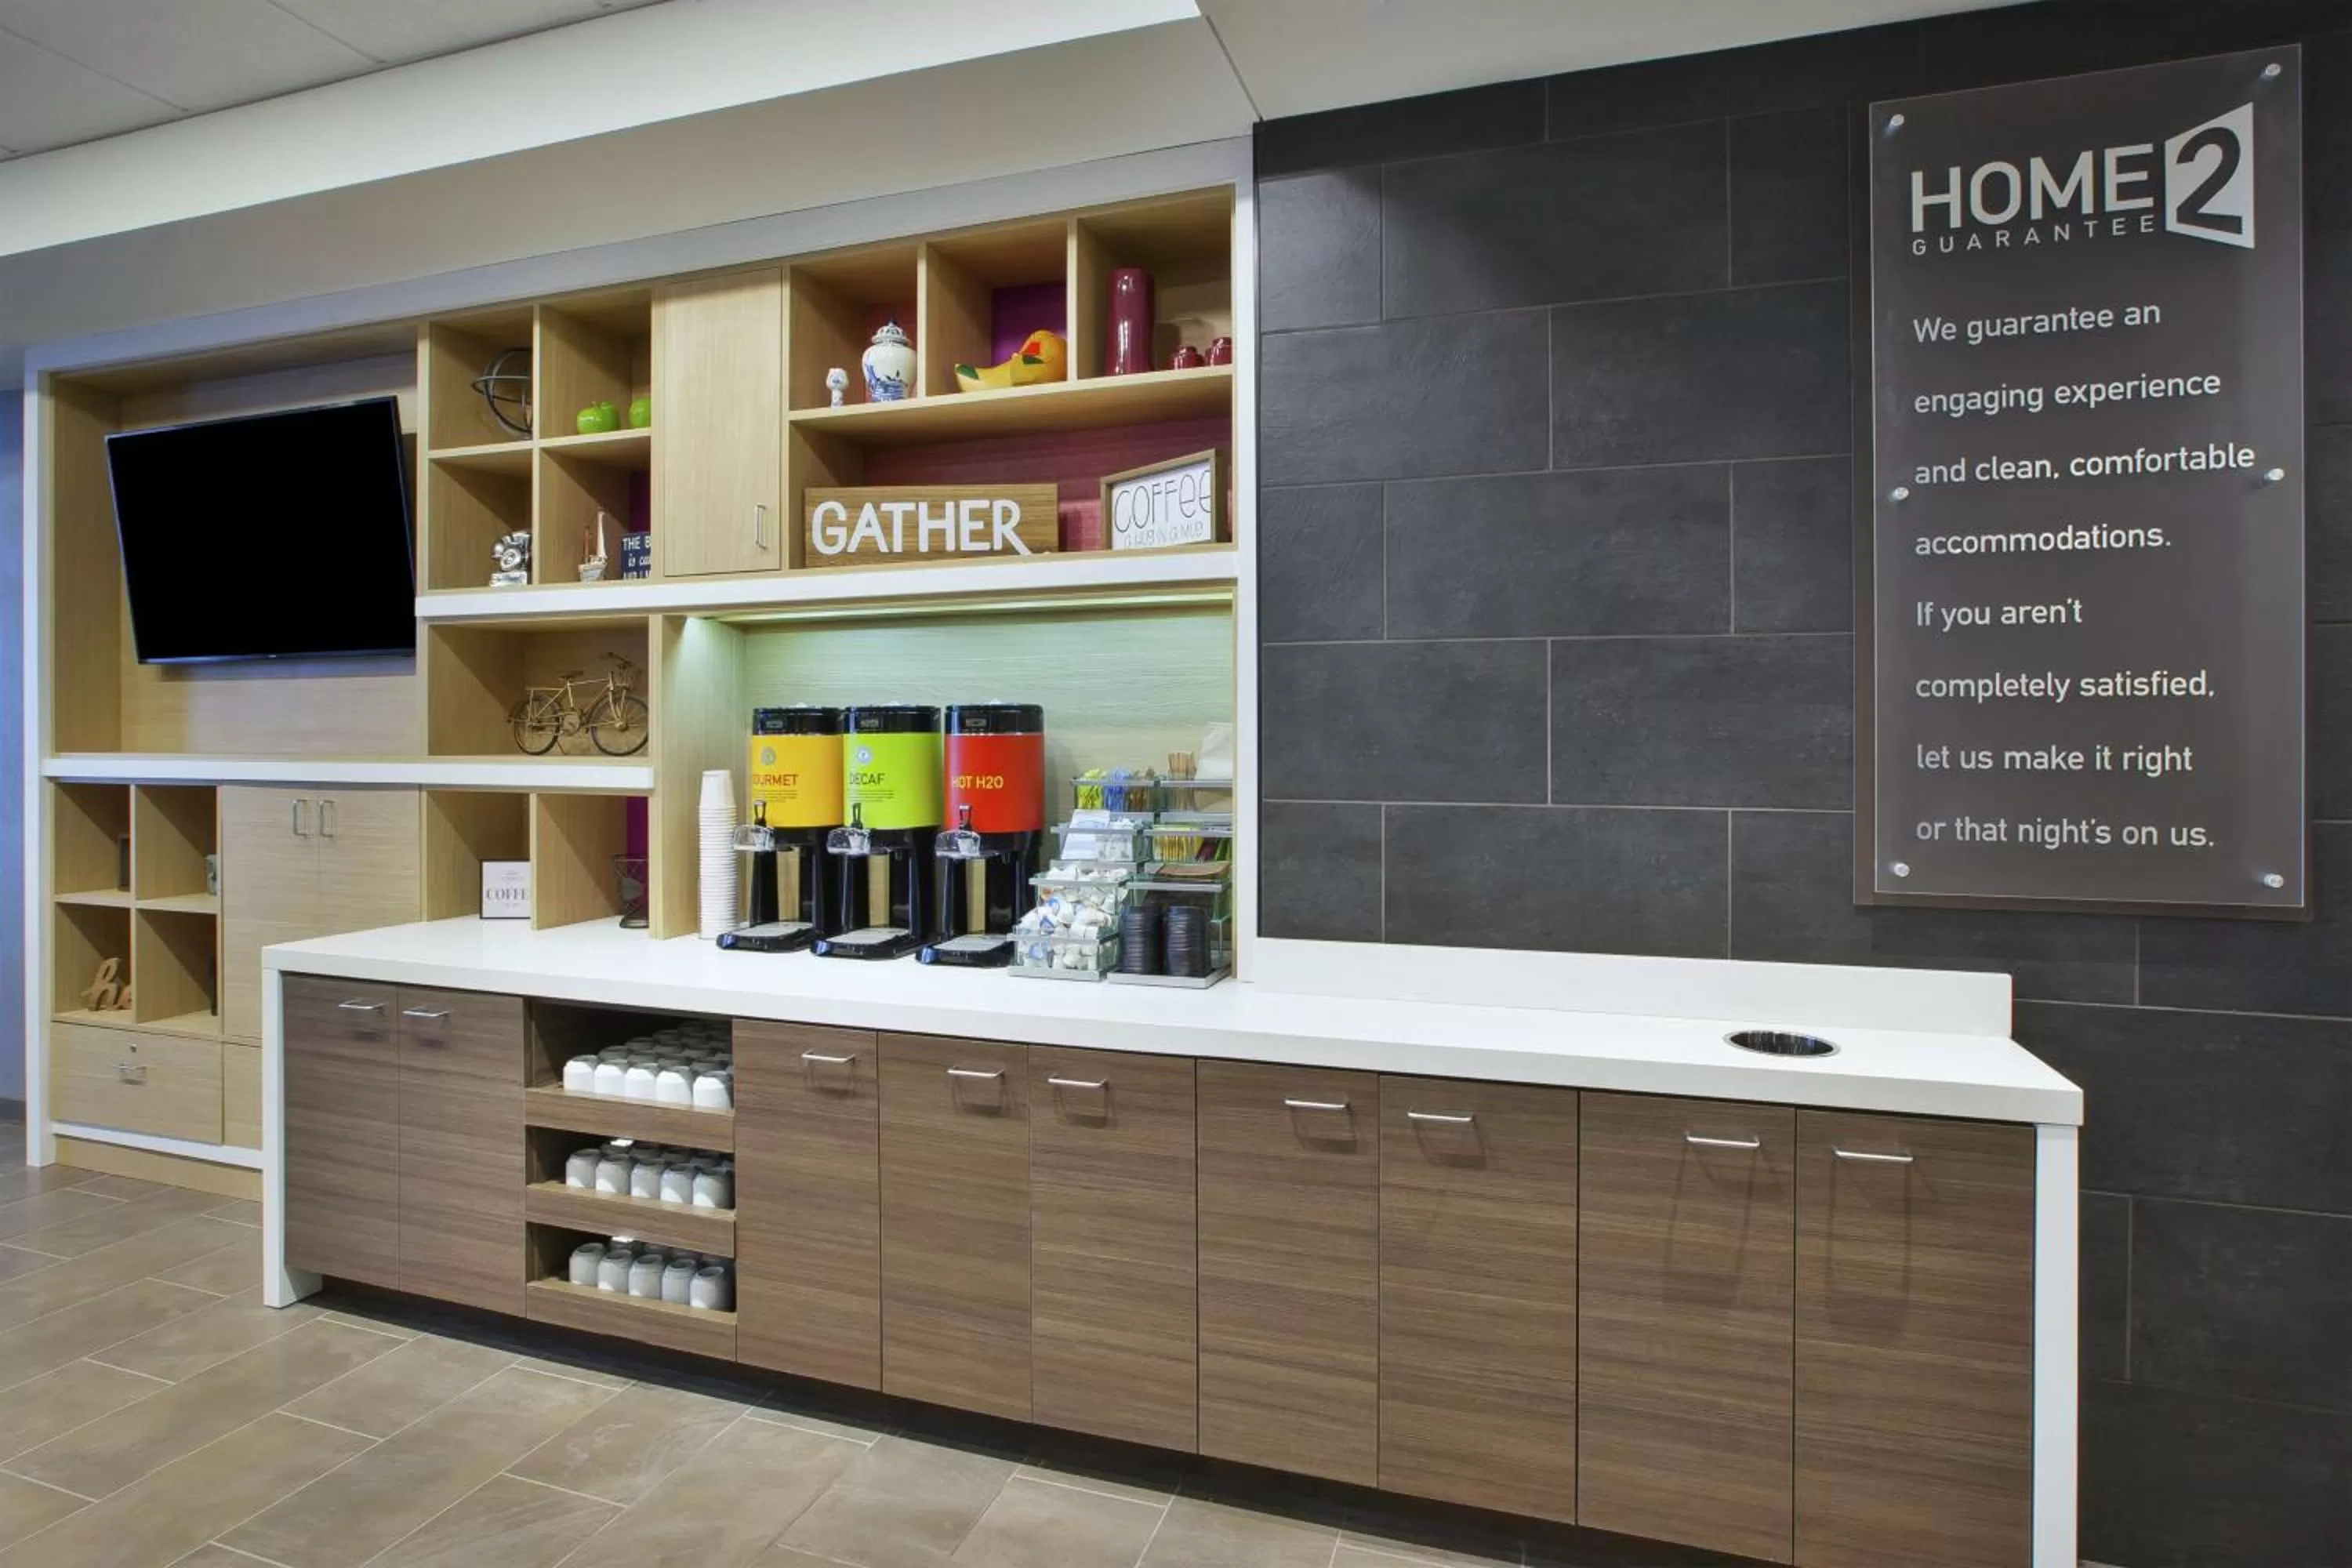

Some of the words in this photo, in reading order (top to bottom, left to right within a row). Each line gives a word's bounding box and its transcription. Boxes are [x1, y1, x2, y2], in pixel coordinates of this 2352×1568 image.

[1912, 214, 2155, 256] GUARANTEE
[1913, 316, 1958, 343] We
[1966, 307, 2114, 346] guarantee
[2123, 304, 2161, 326] an
[1914, 382, 2044, 418] engaging
[2054, 372, 2222, 409] experience
[1915, 456, 1966, 485] and
[2069, 441, 2256, 477] comfortable
[811, 499, 1035, 556] GATHER
[1915, 522, 2171, 556] accommodations.
[1917, 601, 1934, 627] If
[1941, 604, 1991, 633] you
[2000, 597, 2083, 625] aren't
[1915, 672, 2071, 704] completely
[849, 772, 886, 786] DECAF
[1917, 743, 1951, 769] let
[1959, 750, 1994, 770] us
[2003, 744, 2085, 771] make
[2095, 744, 2113, 771] it
[2122, 744, 2194, 779] right
[953, 775, 973, 789] HOT
[1916, 820, 1946, 841] or
[1954, 815, 2008, 842] that
[2017, 818, 2112, 851] night's
[2122, 826, 2159, 846] on
[2170, 826, 2215, 848] us.
